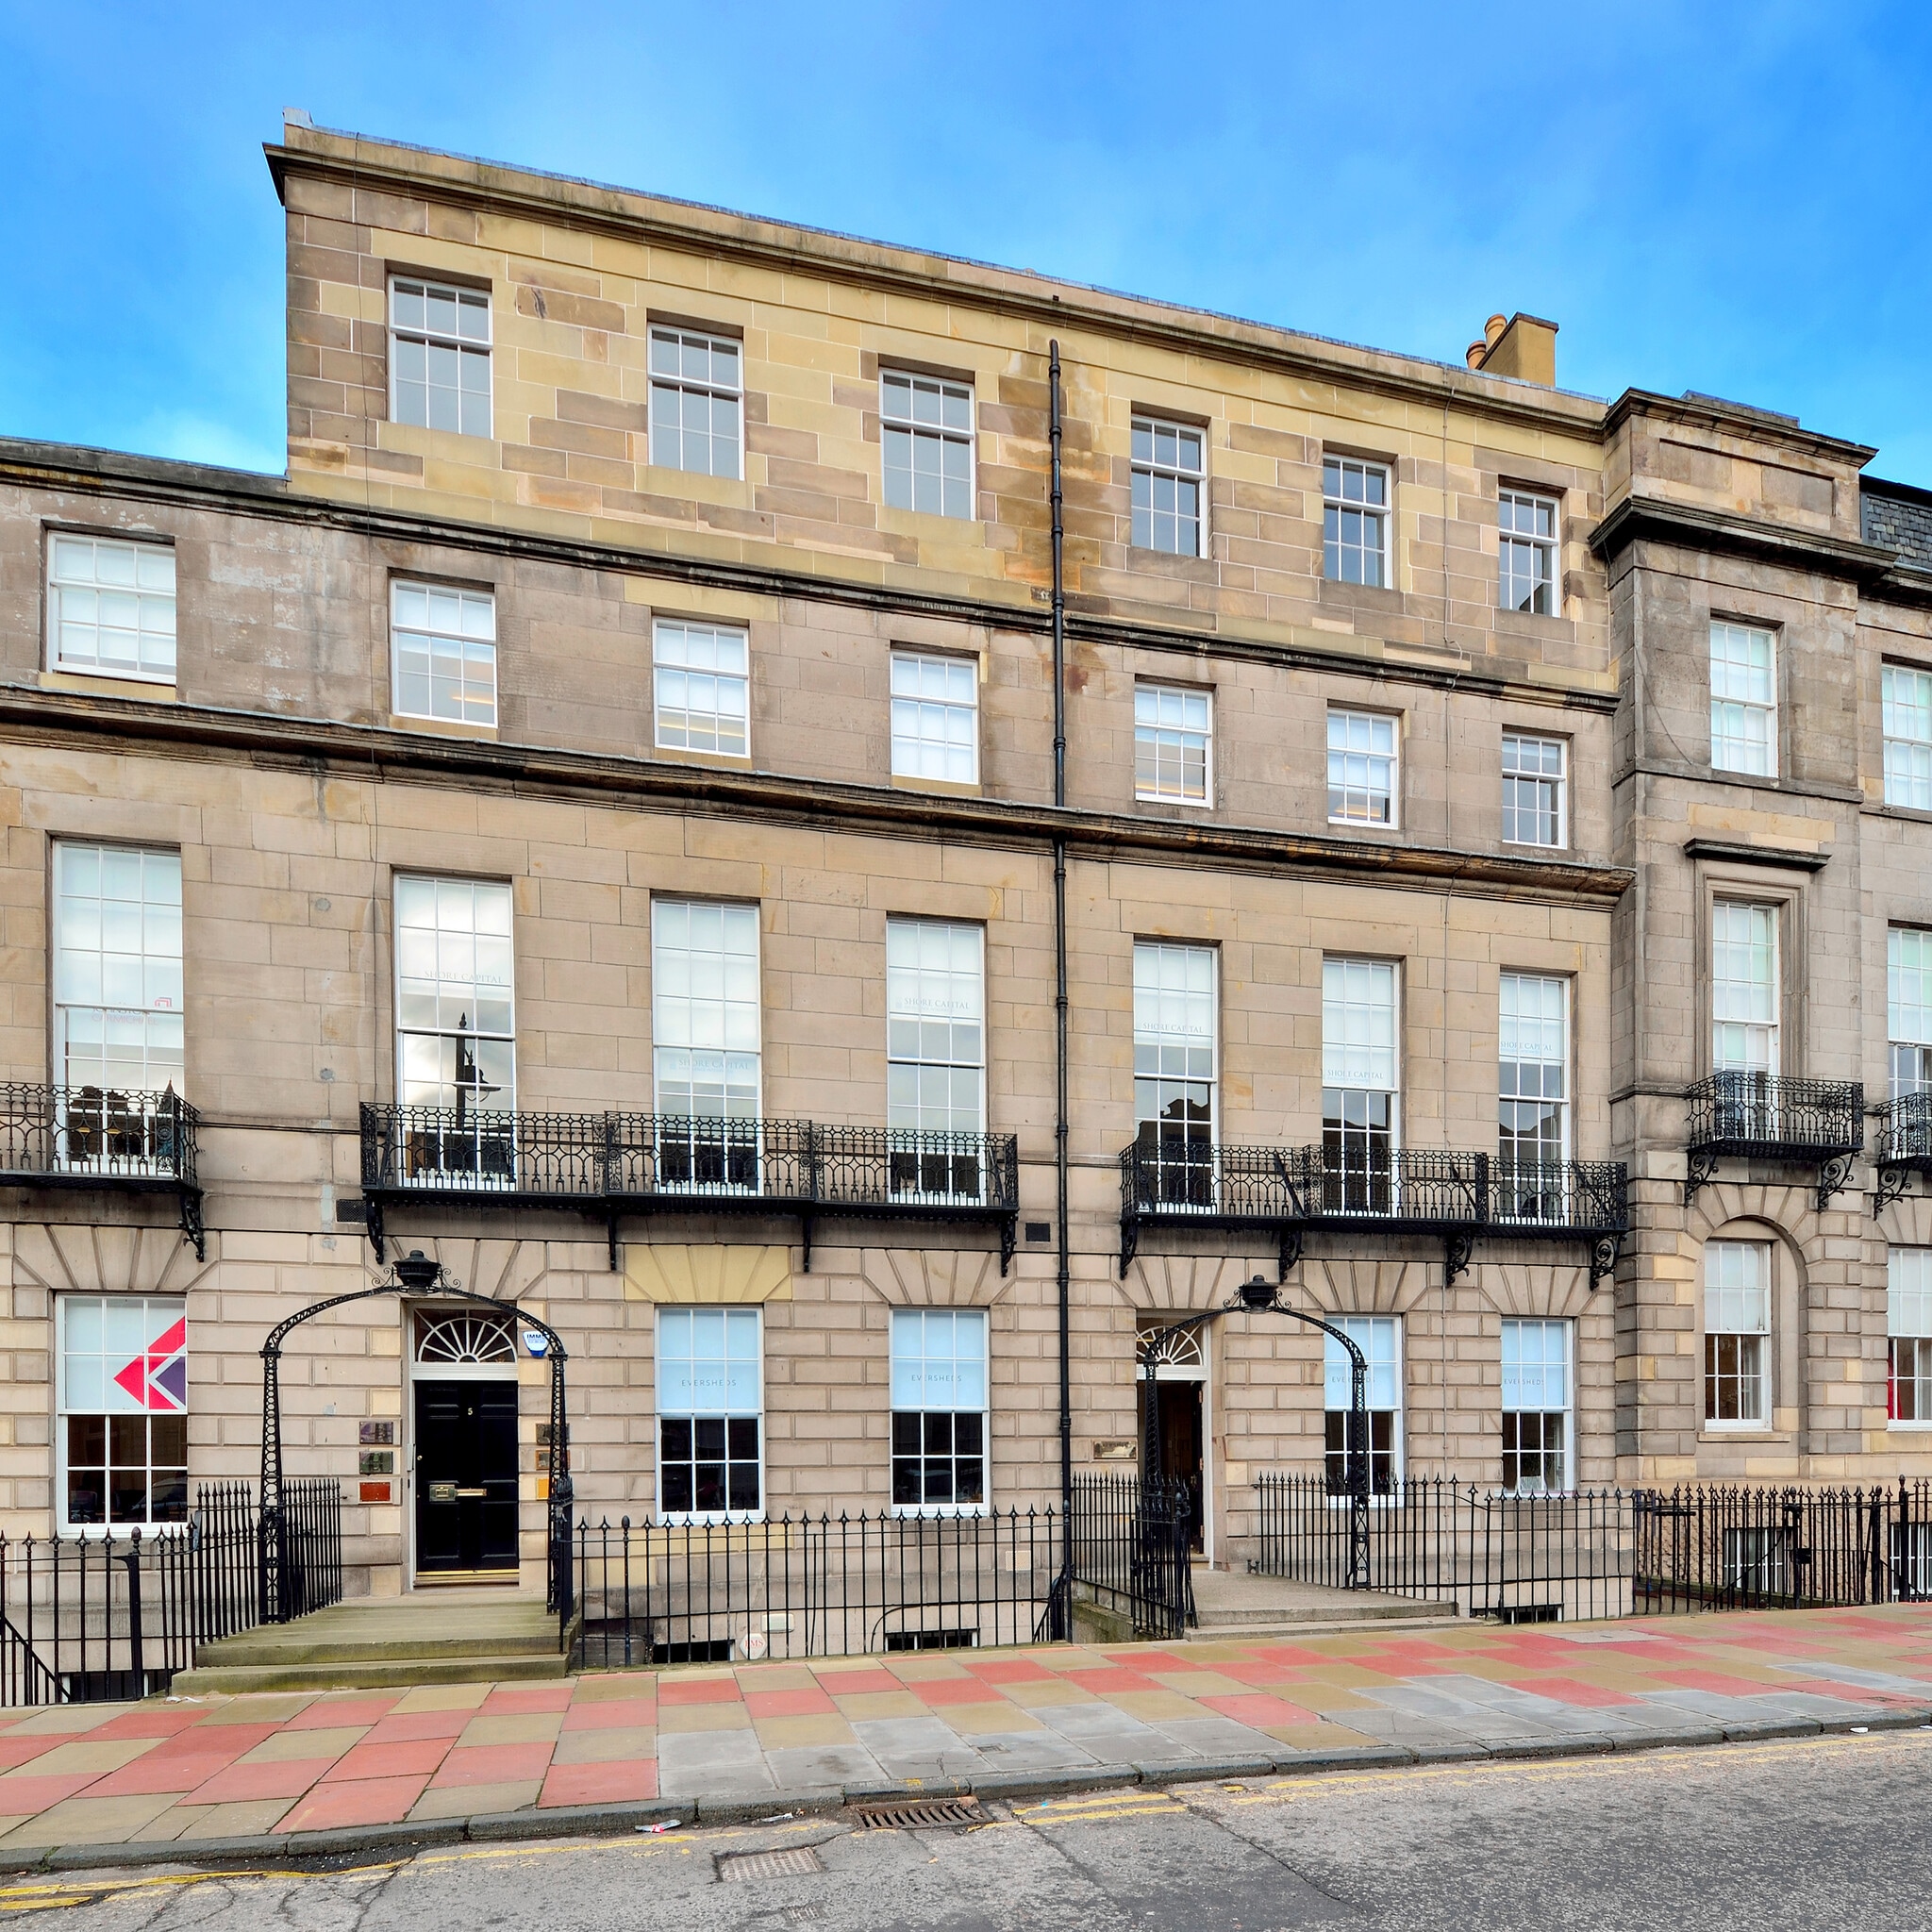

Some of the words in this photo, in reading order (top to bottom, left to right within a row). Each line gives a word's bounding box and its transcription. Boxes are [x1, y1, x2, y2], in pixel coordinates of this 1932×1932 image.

[1171, 1024, 1204, 1034] CAPTAL
[1524, 1042, 1553, 1052] CAPIAL
[681, 1378, 737, 1387] EVERSHEDS
[467, 1407, 474, 1416] 5
